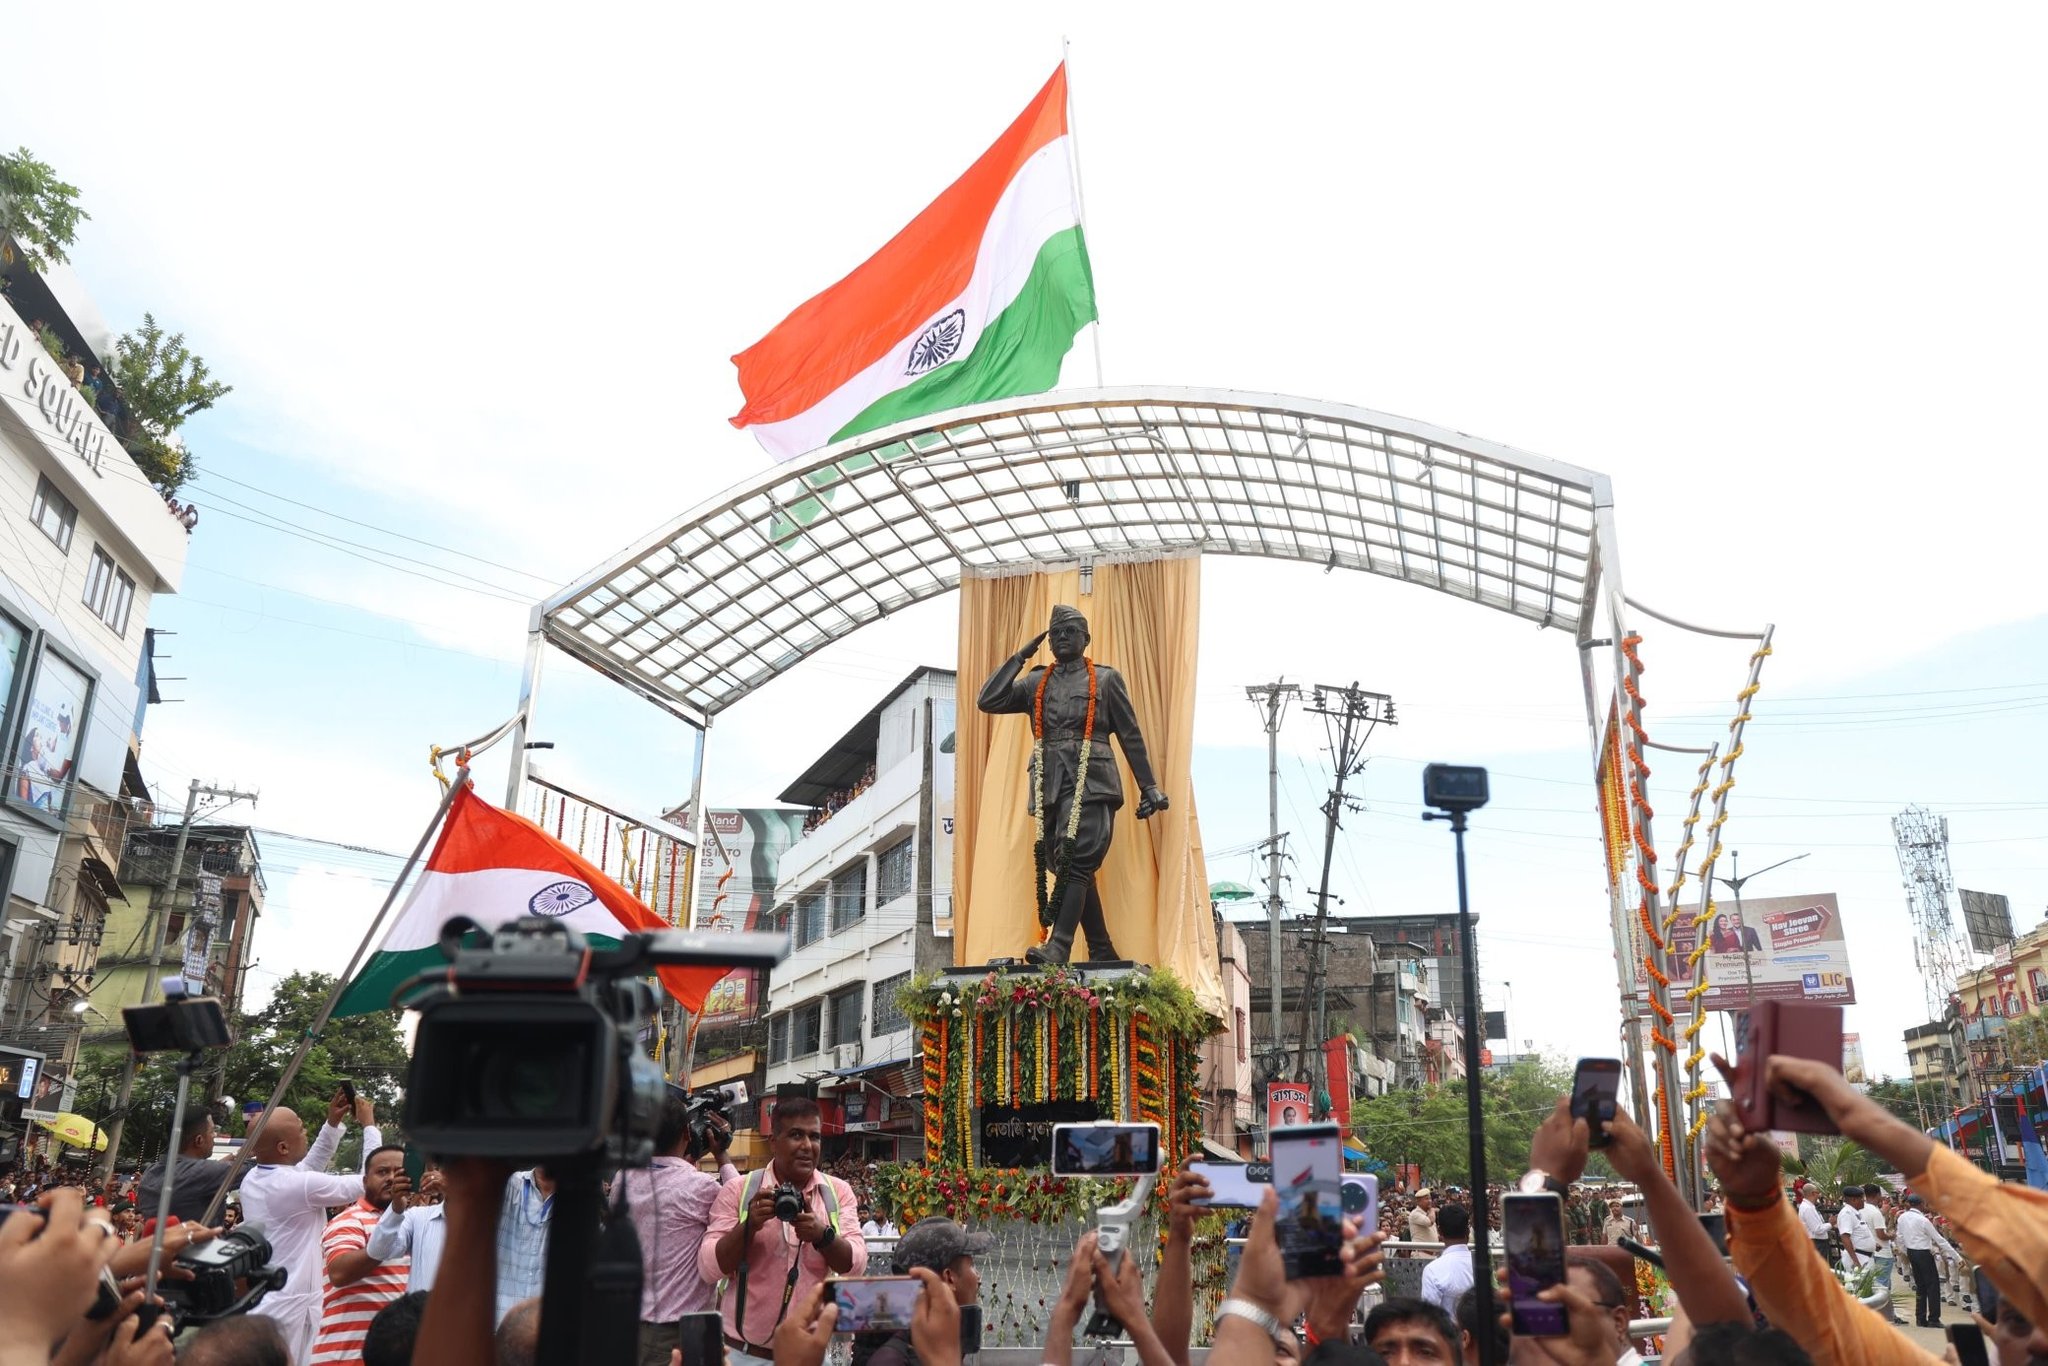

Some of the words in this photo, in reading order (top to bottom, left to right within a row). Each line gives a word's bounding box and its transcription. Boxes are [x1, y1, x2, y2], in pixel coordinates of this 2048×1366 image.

[0, 323, 20, 370] D
[24, 357, 109, 479] SQUARE
[1788, 914, 1819, 928] Jeevan
[1783, 924, 1810, 937] Shree
[1715, 960, 1745, 968] Premium
[1821, 972, 1844, 987] LIC
[1026, 1119, 1055, 1143] সুভা
